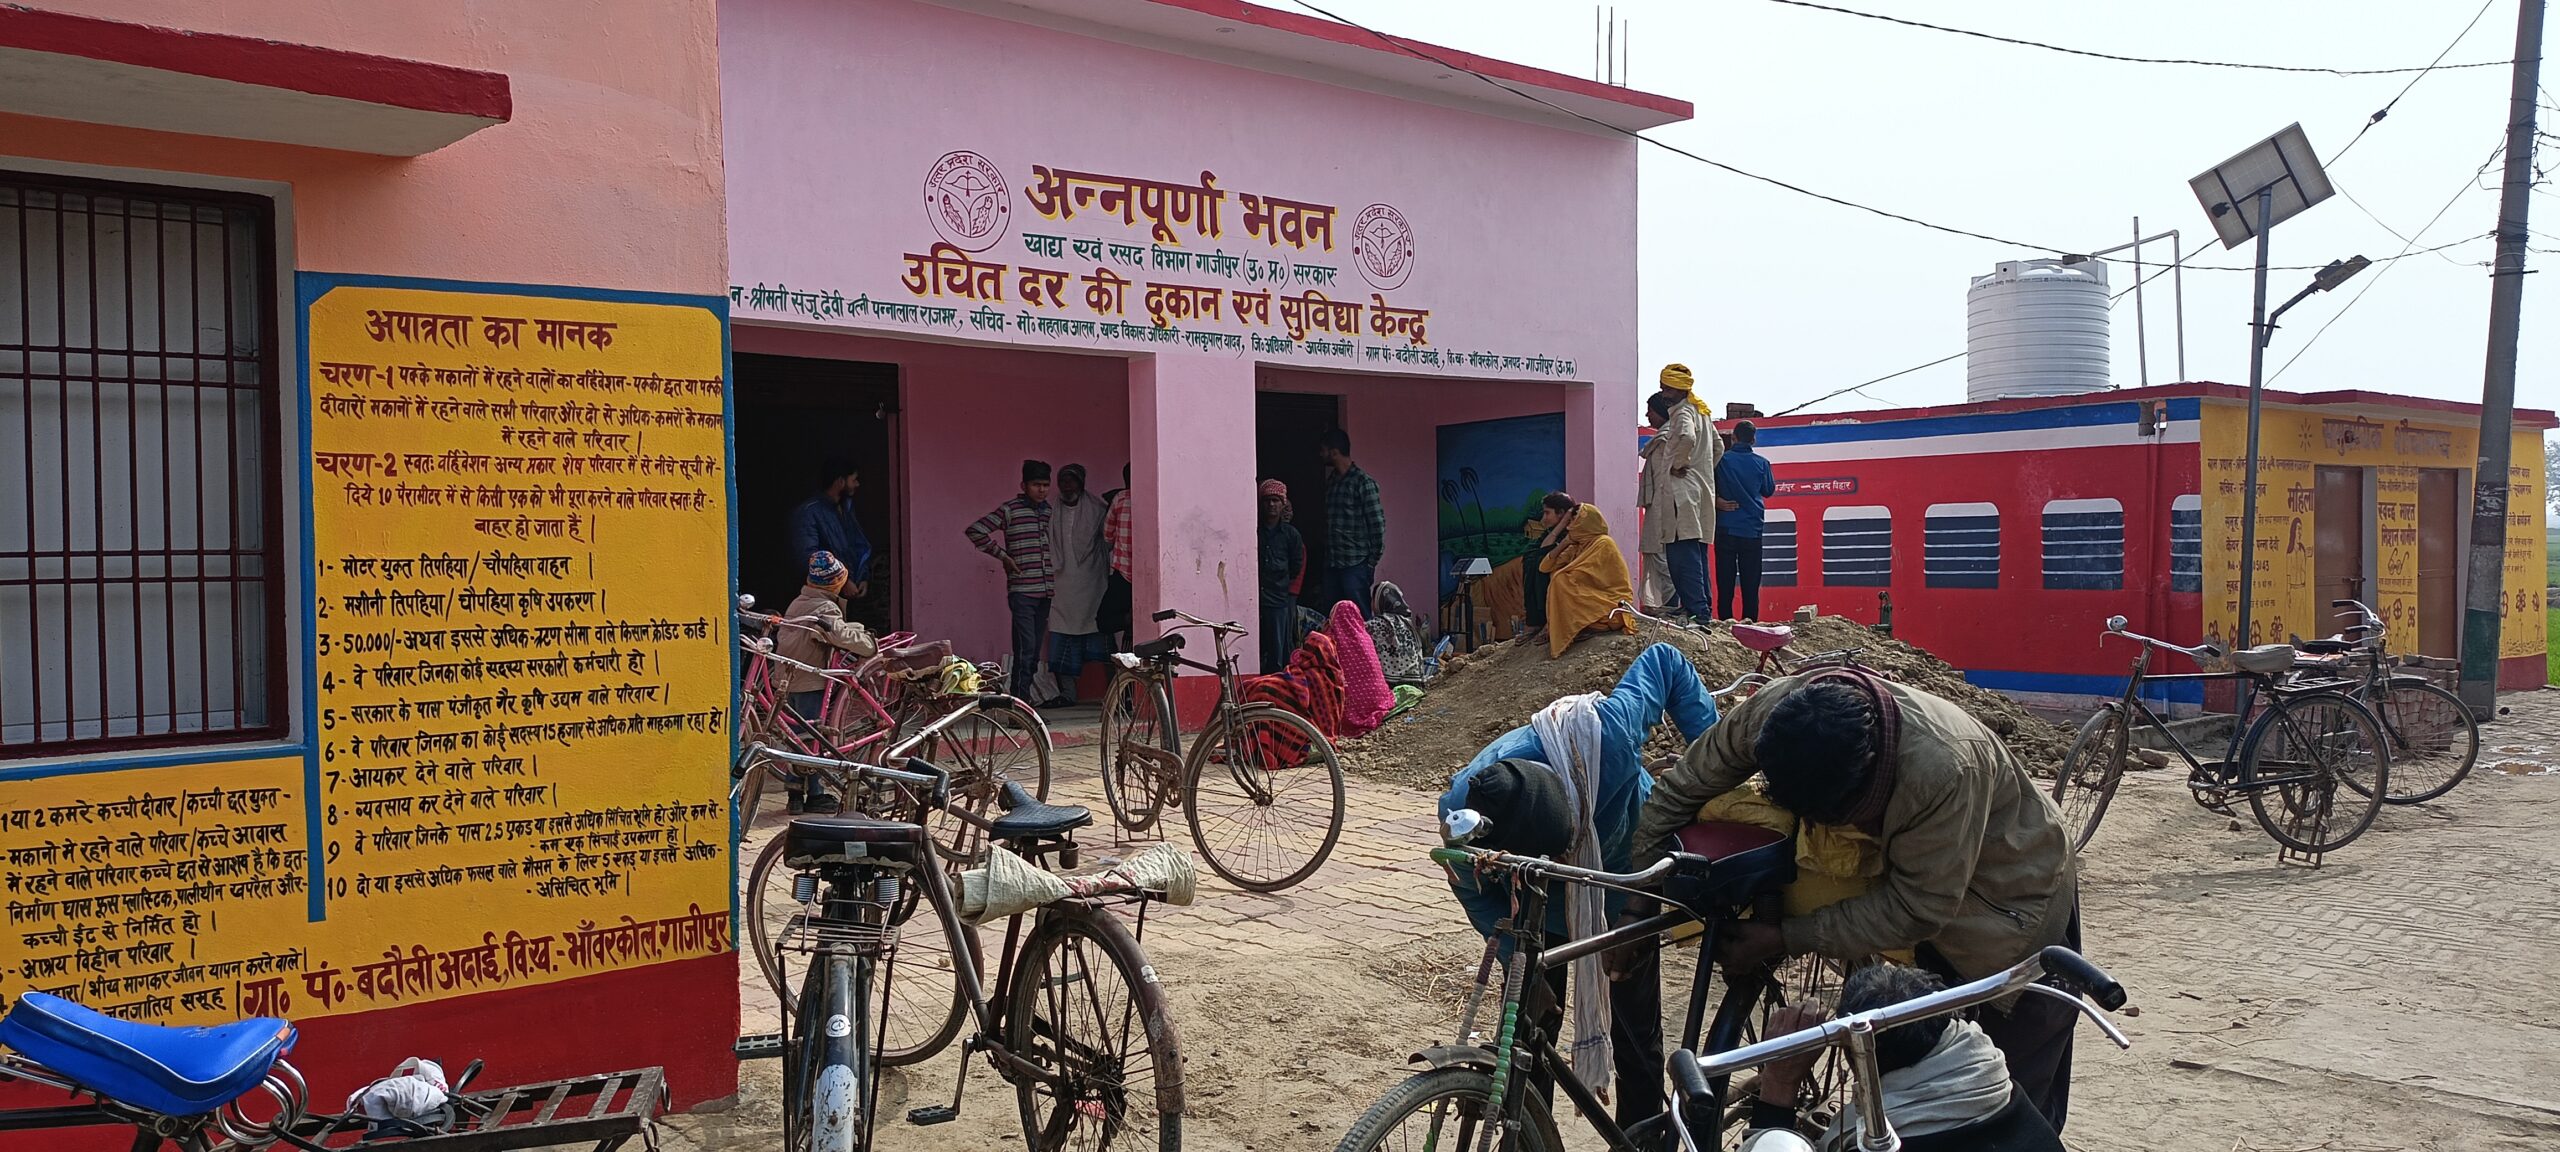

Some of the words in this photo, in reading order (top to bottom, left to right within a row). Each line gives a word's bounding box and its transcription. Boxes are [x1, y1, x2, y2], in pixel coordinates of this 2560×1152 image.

[1024, 165, 1226, 245] अन्नपूर्णा
[1239, 192, 1338, 255] भवन
[1022, 233, 1067, 259] खाद्य
[1073, 238, 1103, 262] एवं
[1108, 243, 1145, 270] रसद
[1151, 243, 1192, 274] विभाग
[1195, 248, 1241, 278] गाजीपुर
[901, 242, 1007, 304] उचित
[1018, 266, 1072, 310] दर
[1080, 266, 1132, 316] की
[1144, 281, 1224, 328] दुकान
[1232, 288, 1271, 326] एवं
[1280, 290, 1363, 341] सुविधा
[1370, 293, 1429, 345] केन्द्र
[365, 309, 474, 350] अपात्रता
[481, 315, 528, 351] का
[533, 318, 618, 352] मानक
[791, 290, 825, 321] संजू
[821, 289, 844, 319] देवी
[1121, 320, 1146, 342] विकास
[501, 426, 516, 445] में
[518, 427, 551, 450] रहने
[552, 428, 578, 448] वाले
[583, 428, 630, 453] परिवार
[494, 456, 524, 474] अन्य
[562, 452, 586, 474] शेष
[588, 453, 625, 475] परिवार
[627, 455, 639, 475] में
[641, 454, 652, 475] से
[654, 453, 678, 476] नीचे
[679, 453, 703, 480] सूची
[2288, 481, 2314, 514] महिला
[474, 518, 512, 538] बाहर
[515, 514, 532, 541] हो
[534, 519, 565, 538] जाता
[568, 512, 586, 544] हैं
[341, 554, 377, 578] मोटर
[482, 549, 537, 579] चौपहिया
[537, 556, 572, 580] वाहन
[343, 588, 386, 618] मशीनी
[458, 586, 515, 617] चौपहिया
[517, 587, 546, 618] कृषि
[545, 591, 596, 613] उपकरण
[353, 663, 368, 690] वे
[372, 661, 417, 688] परिवार
[417, 659, 460, 685] जिनका
[460, 656, 484, 683] कोई
[485, 659, 524, 678] सदस्य
[526, 650, 569, 678] सरकारी
[573, 647, 622, 674] कर्मचारी
[627, 648, 646, 676] हो
[351, 703, 397, 725] सरकार
[398, 697, 411, 722] के
[415, 700, 444, 719] पास
[447, 693, 493, 720] पंजीकृत
[496, 687, 517, 714] गैर
[521, 686, 549, 716] कृषि
[550, 690, 583, 711] उद्यम
[587, 684, 611, 706] वाले
[615, 682, 660, 704] परिवार
[349, 767, 407, 789] आयकर
[415, 760, 439, 786] देने
[445, 757, 476, 780] वाले
[482, 754, 525, 776] परिवार
[355, 796, 414, 820] व्यवसाय
[418, 794, 441, 815] कर
[443, 788, 466, 815] देने
[470, 785, 500, 810] वाले
[503, 782, 548, 807] परिवार
[6, 897, 60, 926] निर्माण
[61, 897, 93, 920] घास
[22, 924, 69, 949] कच्ची
[102, 920, 119, 941] से
[122, 913, 175, 938] निर्मित
[181, 910, 201, 936] हो
[353, 943, 436, 1002] बदौली
